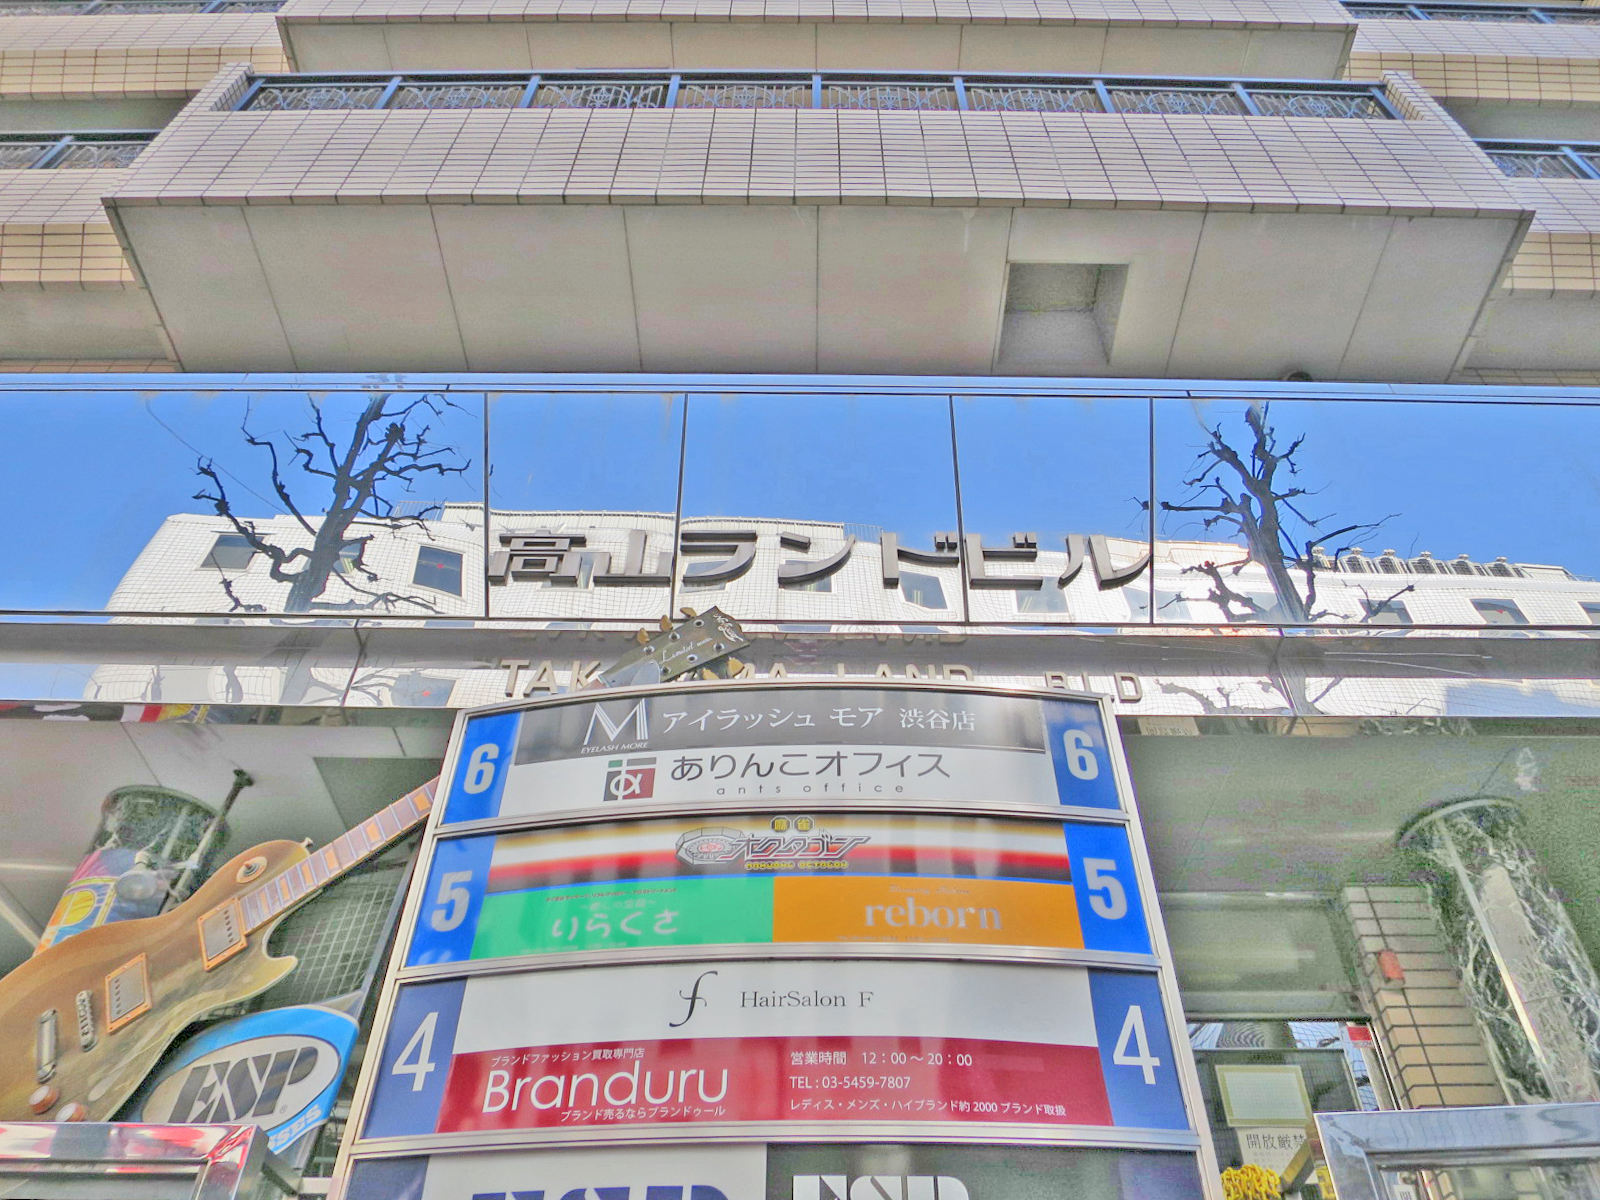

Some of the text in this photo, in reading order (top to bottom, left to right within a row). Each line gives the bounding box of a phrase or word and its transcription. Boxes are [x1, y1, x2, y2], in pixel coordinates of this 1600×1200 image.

[662, 706, 976, 734] アイラッシュ モア 渋谷店
[580, 741, 649, 754] EYELASH MORE
[1062, 728, 1099, 781] 6
[463, 742, 500, 795] 6
[670, 750, 951, 781] ありんこオフィス
[716, 782, 904, 795] ants office
[430, 870, 473, 932] 5
[1082, 857, 1128, 920] 5
[551, 909, 679, 940] りらくさ
[864, 896, 1004, 930] reborn
[740, 990, 875, 1008] HairSalon F
[391, 1011, 439, 1092] 4
[491, 1048, 646, 1067] ブランドファッション買取専門店
[790, 1051, 847, 1066] 営業時間
[1112, 1005, 1161, 1085] 4
[482, 1060, 728, 1113] Branduru
